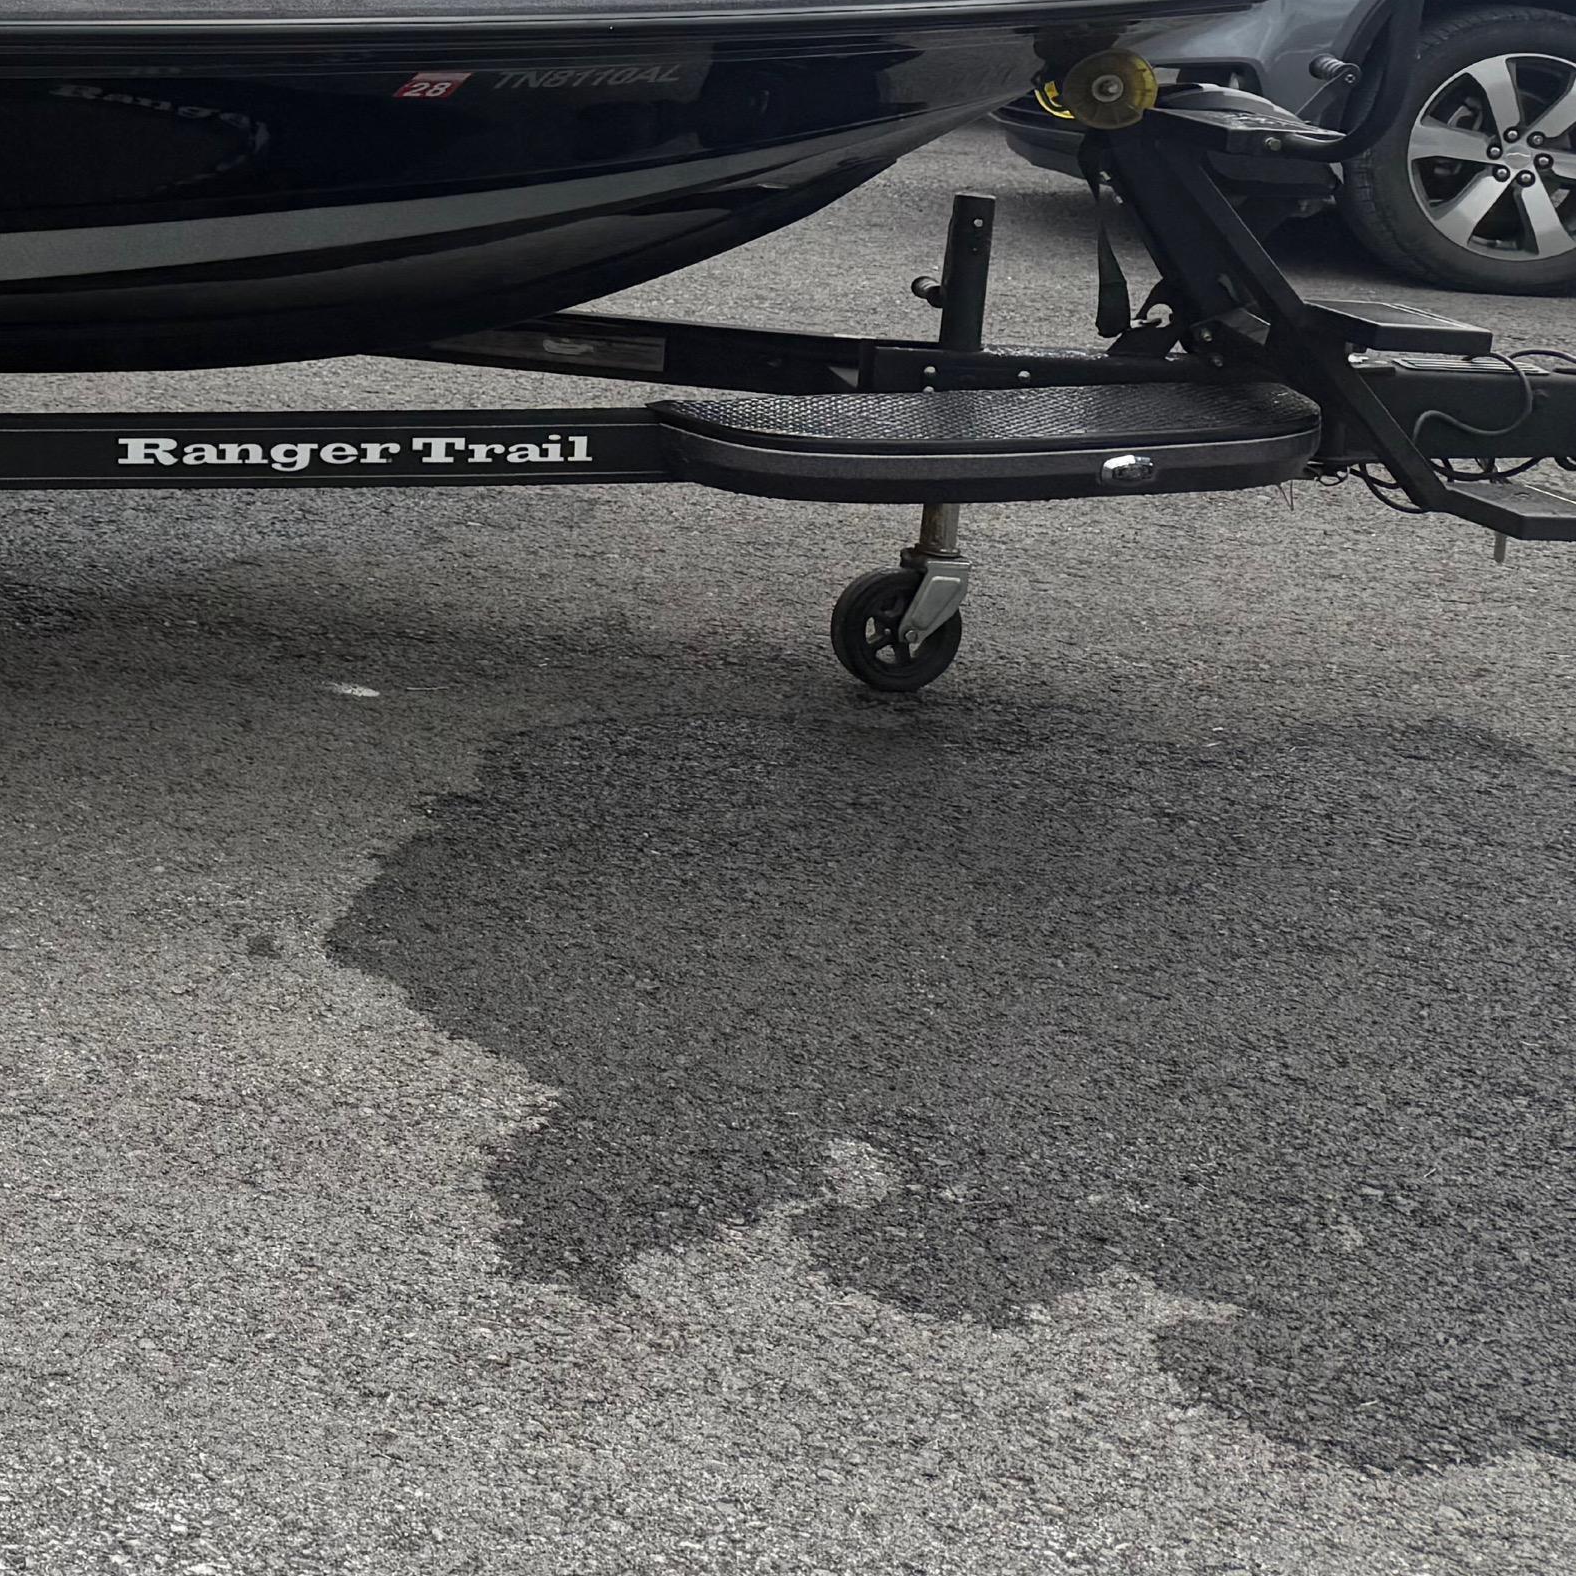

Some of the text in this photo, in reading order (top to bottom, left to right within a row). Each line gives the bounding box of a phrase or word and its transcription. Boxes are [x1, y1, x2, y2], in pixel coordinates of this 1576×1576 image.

[403, 80, 449, 97] 28
[118, 434, 593, 472] Ranger Trail
